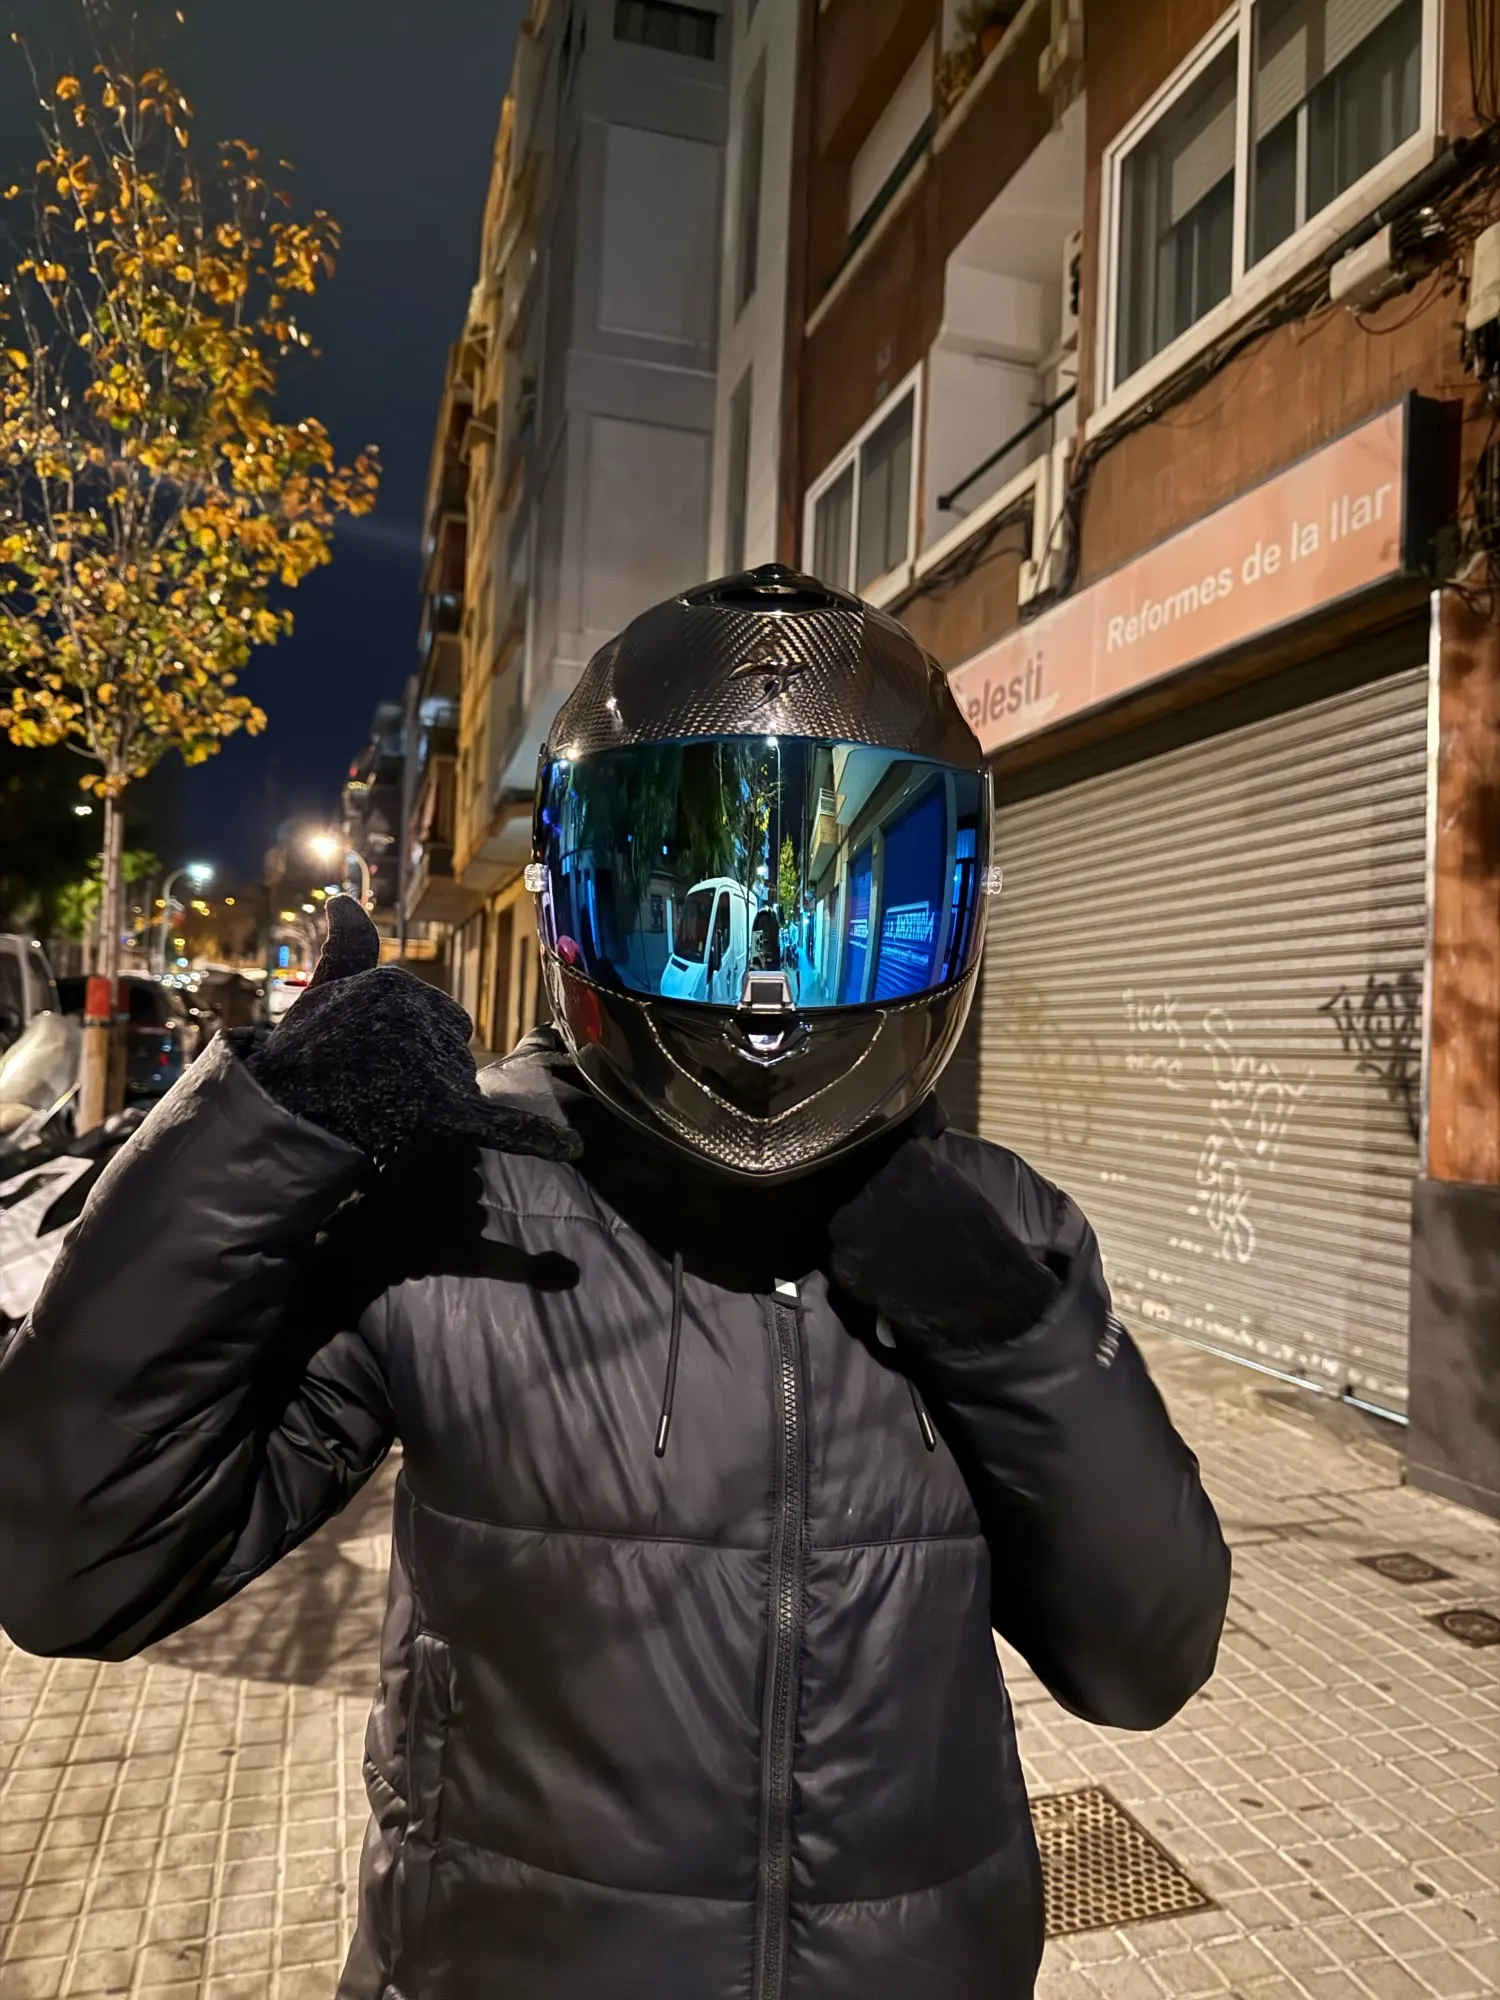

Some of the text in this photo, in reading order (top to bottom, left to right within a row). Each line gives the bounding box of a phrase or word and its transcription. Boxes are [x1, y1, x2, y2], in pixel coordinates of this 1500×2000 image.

[1106, 483, 1392, 654] Reformes de la llar
[954, 650, 1044, 729] elesti
